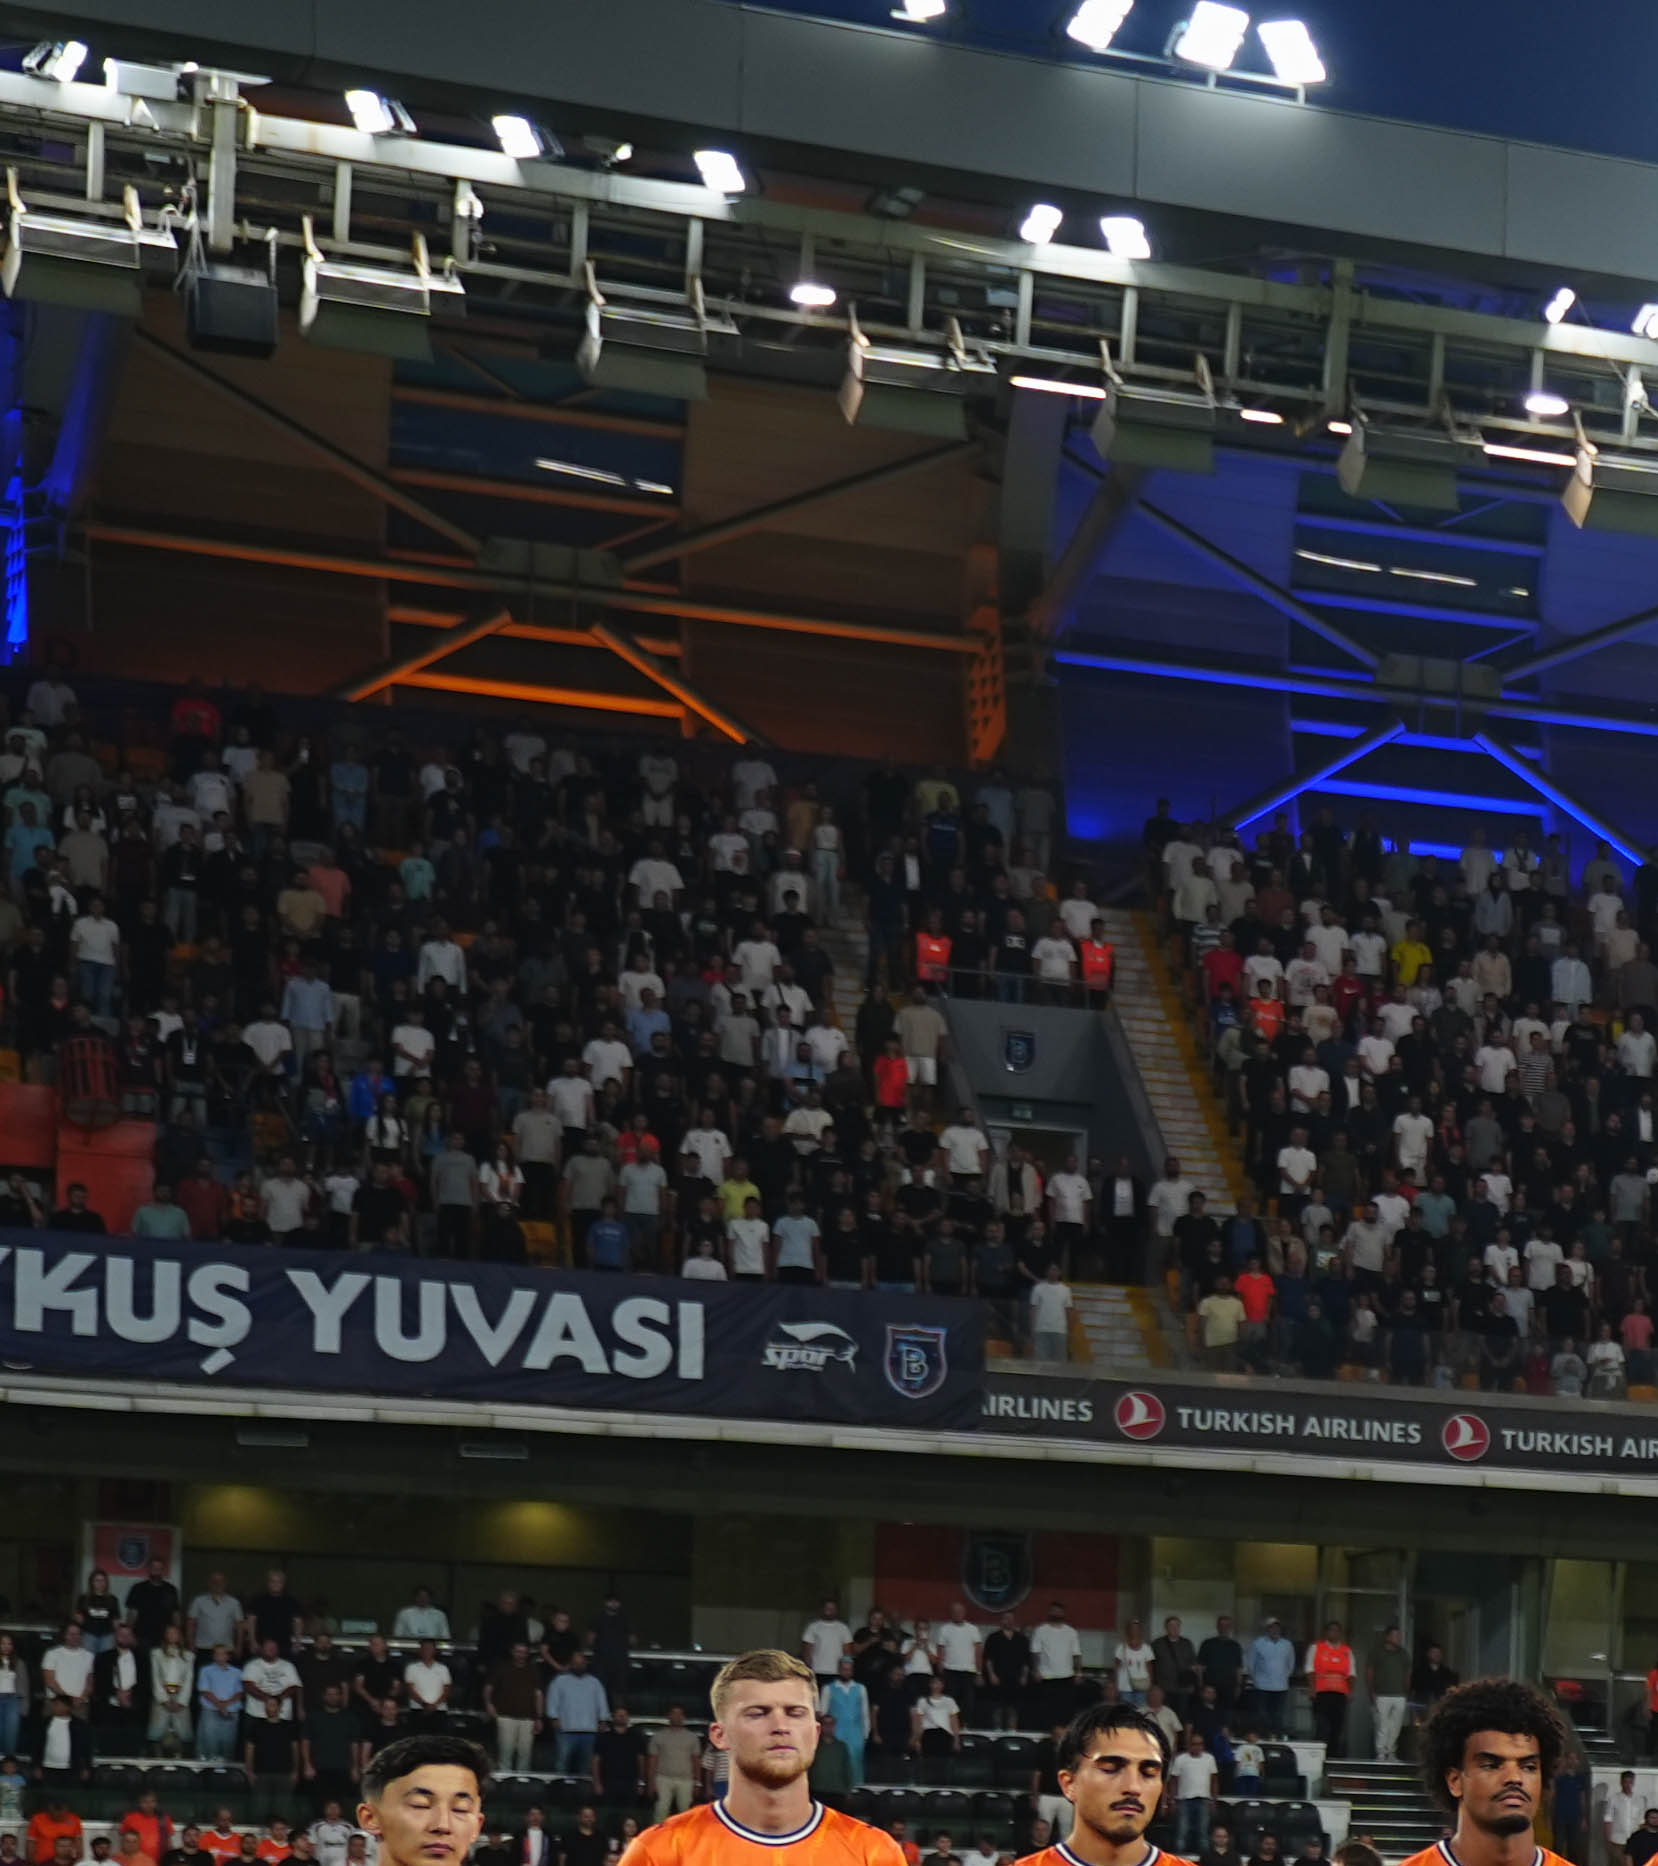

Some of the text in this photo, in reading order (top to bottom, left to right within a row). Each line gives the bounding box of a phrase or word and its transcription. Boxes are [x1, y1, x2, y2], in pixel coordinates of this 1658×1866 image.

[286, 1267, 706, 1380] YUVASI
[1178, 1409, 1420, 1443] TURKISH AIRLINES
[1502, 1430, 1612, 1456] TURKISH
